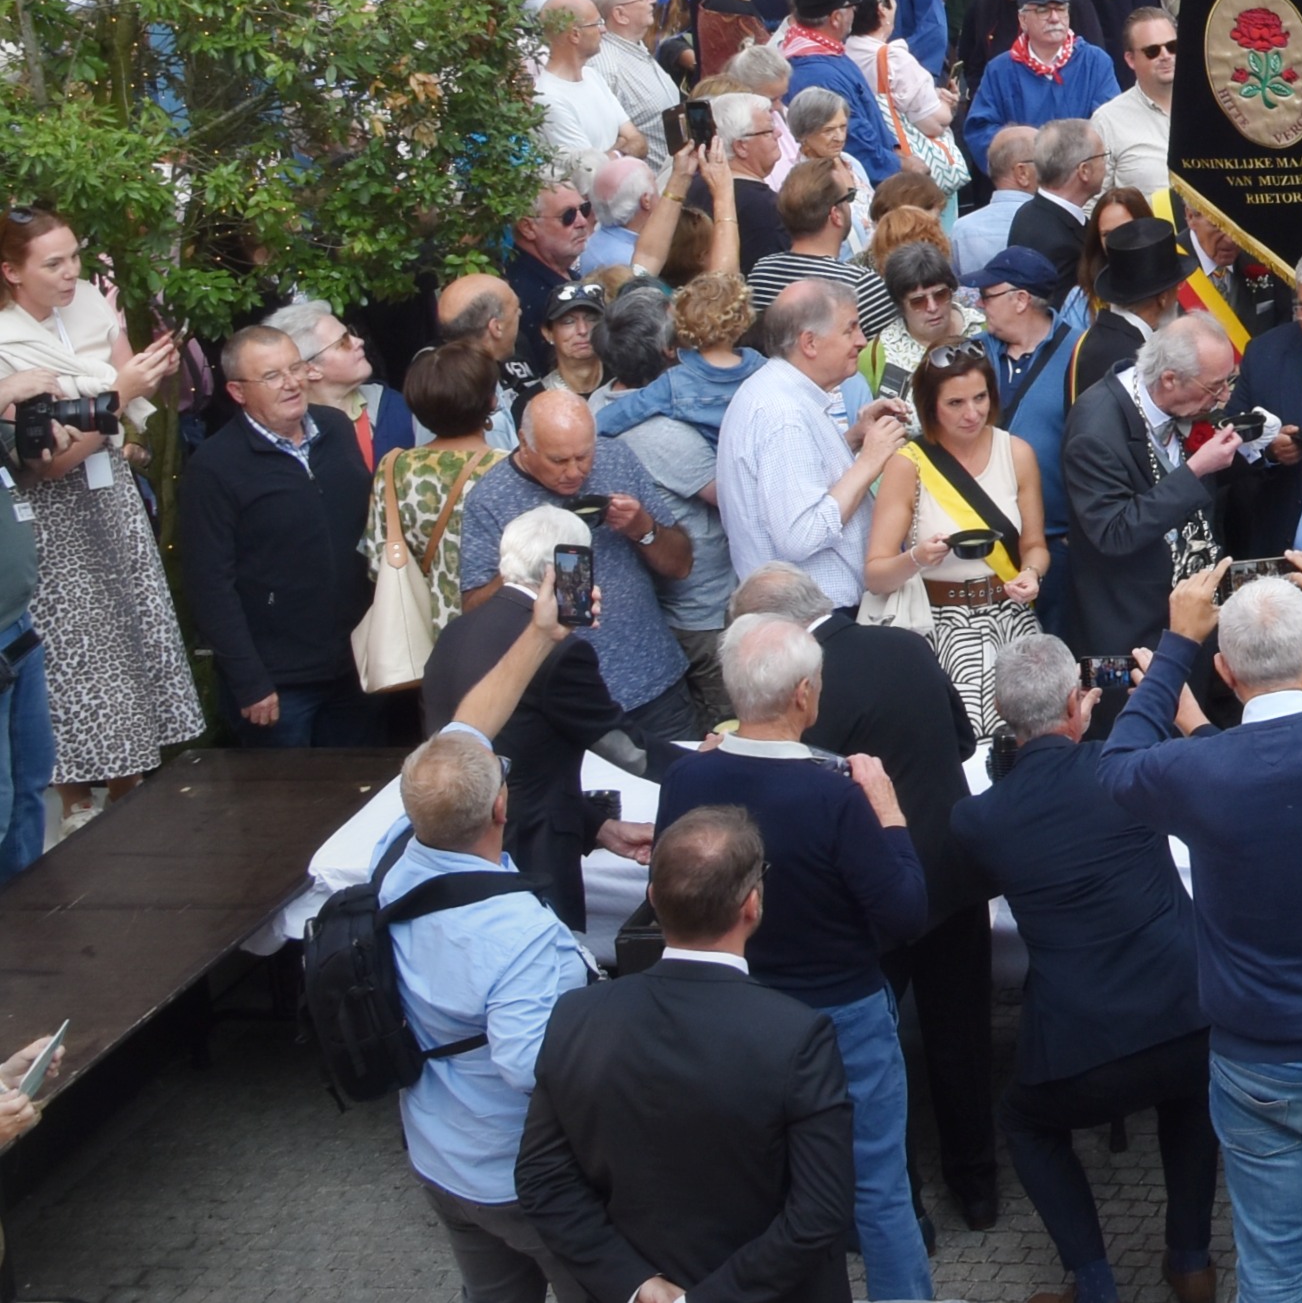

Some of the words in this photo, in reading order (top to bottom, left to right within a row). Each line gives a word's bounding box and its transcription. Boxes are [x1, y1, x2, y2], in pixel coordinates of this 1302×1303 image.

[1217, 87, 1250, 129] HITTE
[1181, 157, 1274, 170] KONINKLIJKE
[1226, 175, 1253, 186] VAN
